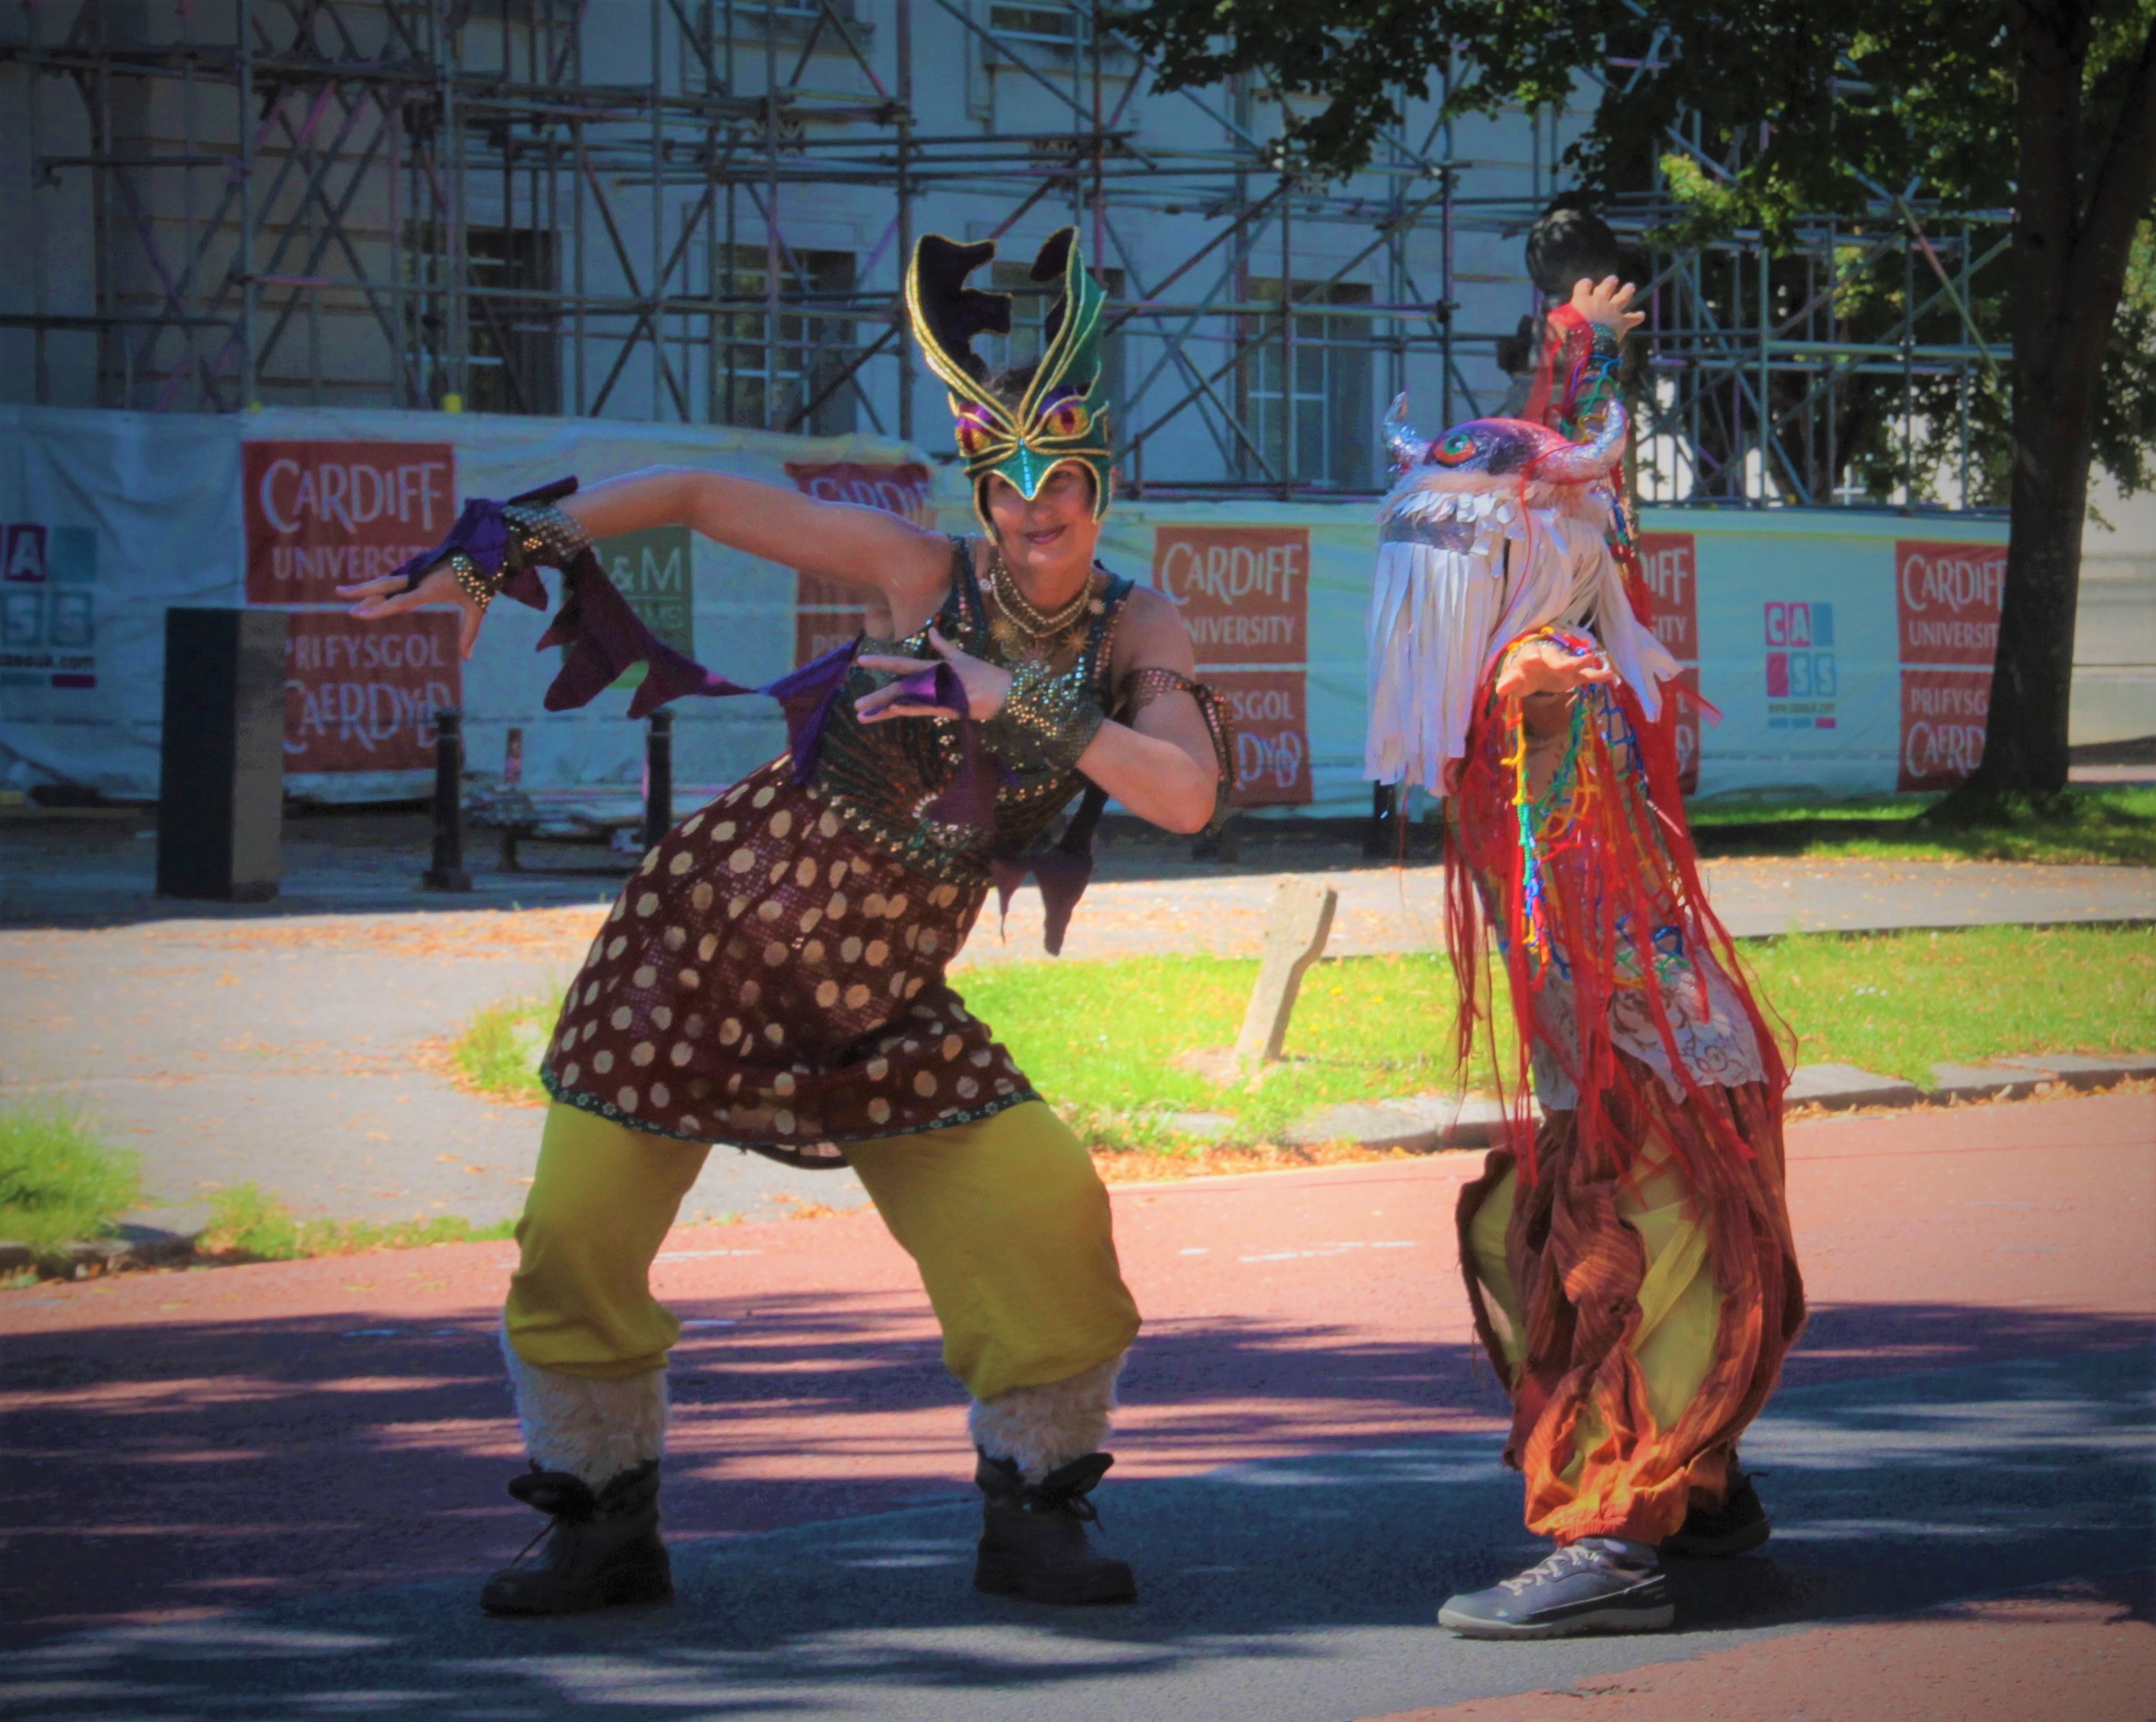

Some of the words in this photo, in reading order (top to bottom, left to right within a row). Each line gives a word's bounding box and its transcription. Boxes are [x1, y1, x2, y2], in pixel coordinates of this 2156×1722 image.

[260, 459, 446, 534] CARDIFF
[272, 546, 431, 580] UNIVERSI
[590, 544, 683, 592] &M
[1163, 541, 1302, 604] CARDIFF
[1182, 615, 1296, 647] NIVERSITY
[1908, 620, 2000, 648] UNIVERSIT
[1910, 687, 1990, 716] PRIFYSG
[1905, 721, 1989, 778] CAERD
